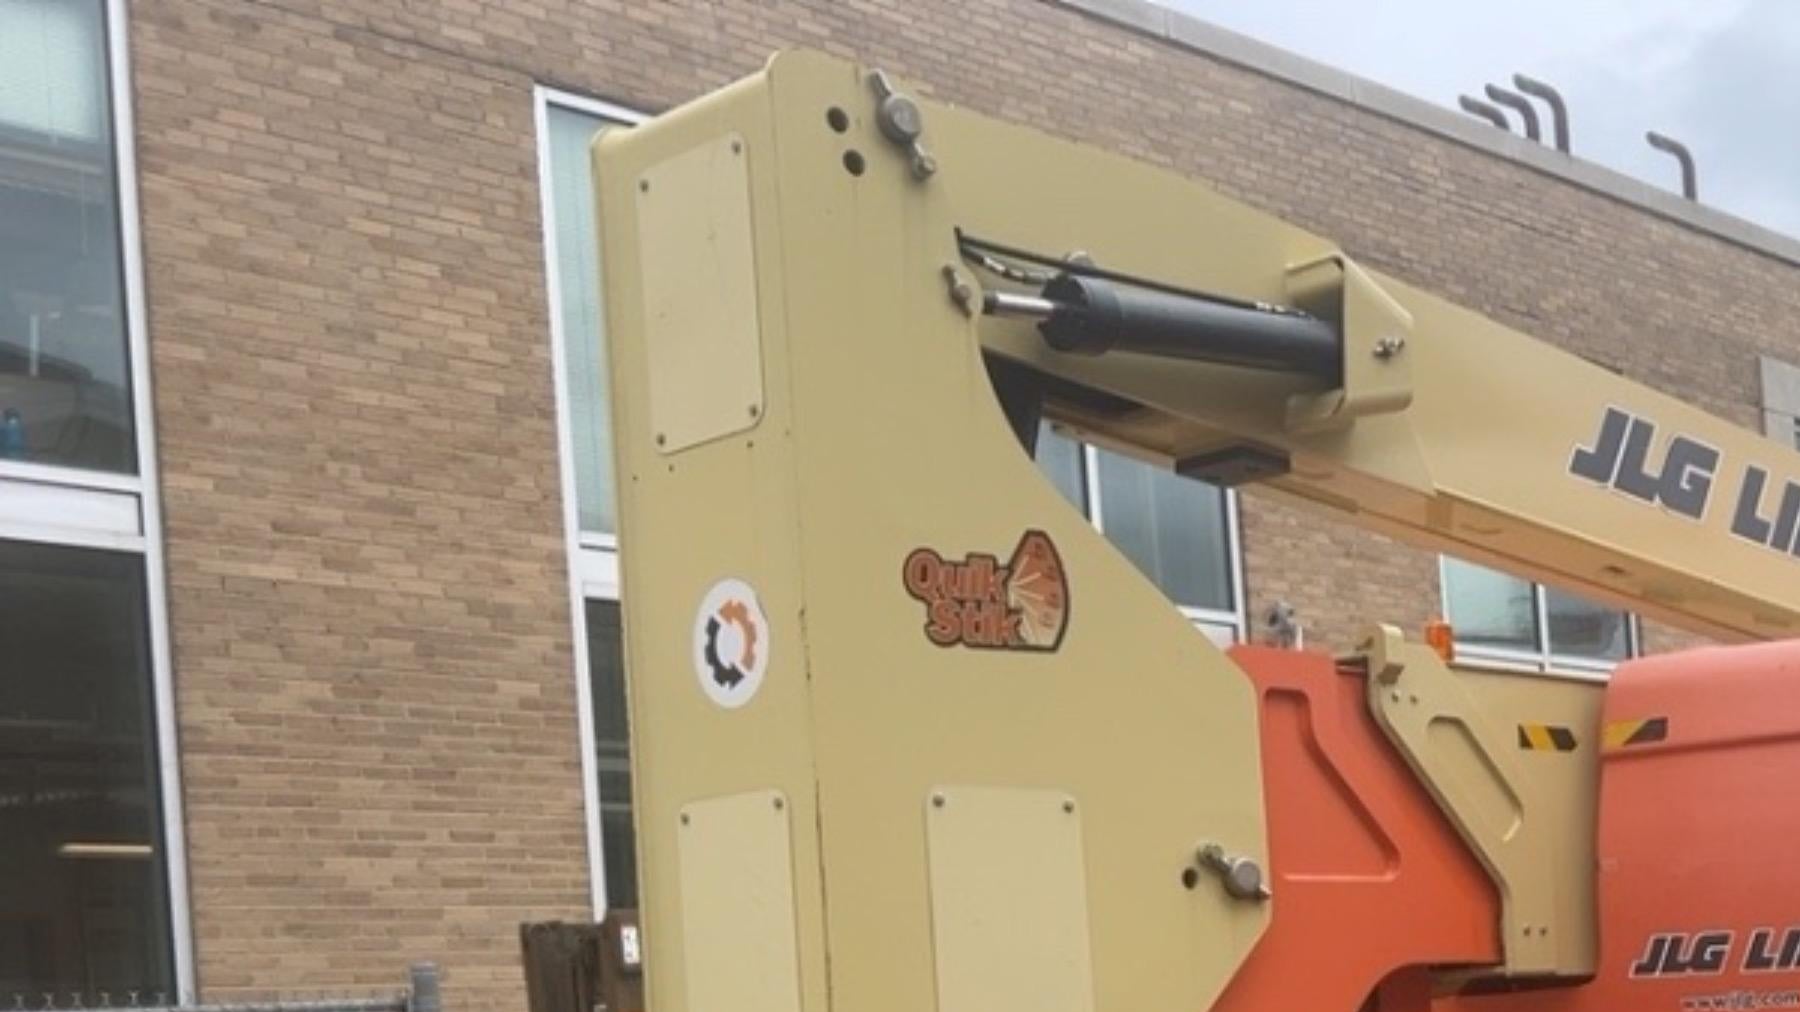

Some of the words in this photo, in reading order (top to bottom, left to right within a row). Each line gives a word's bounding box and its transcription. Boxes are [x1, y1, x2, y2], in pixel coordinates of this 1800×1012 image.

[1568, 406, 1721, 522] JLG
[905, 550, 1010, 604] Quik
[926, 597, 1024, 646] Stik
[1630, 930, 1735, 978] JLG
